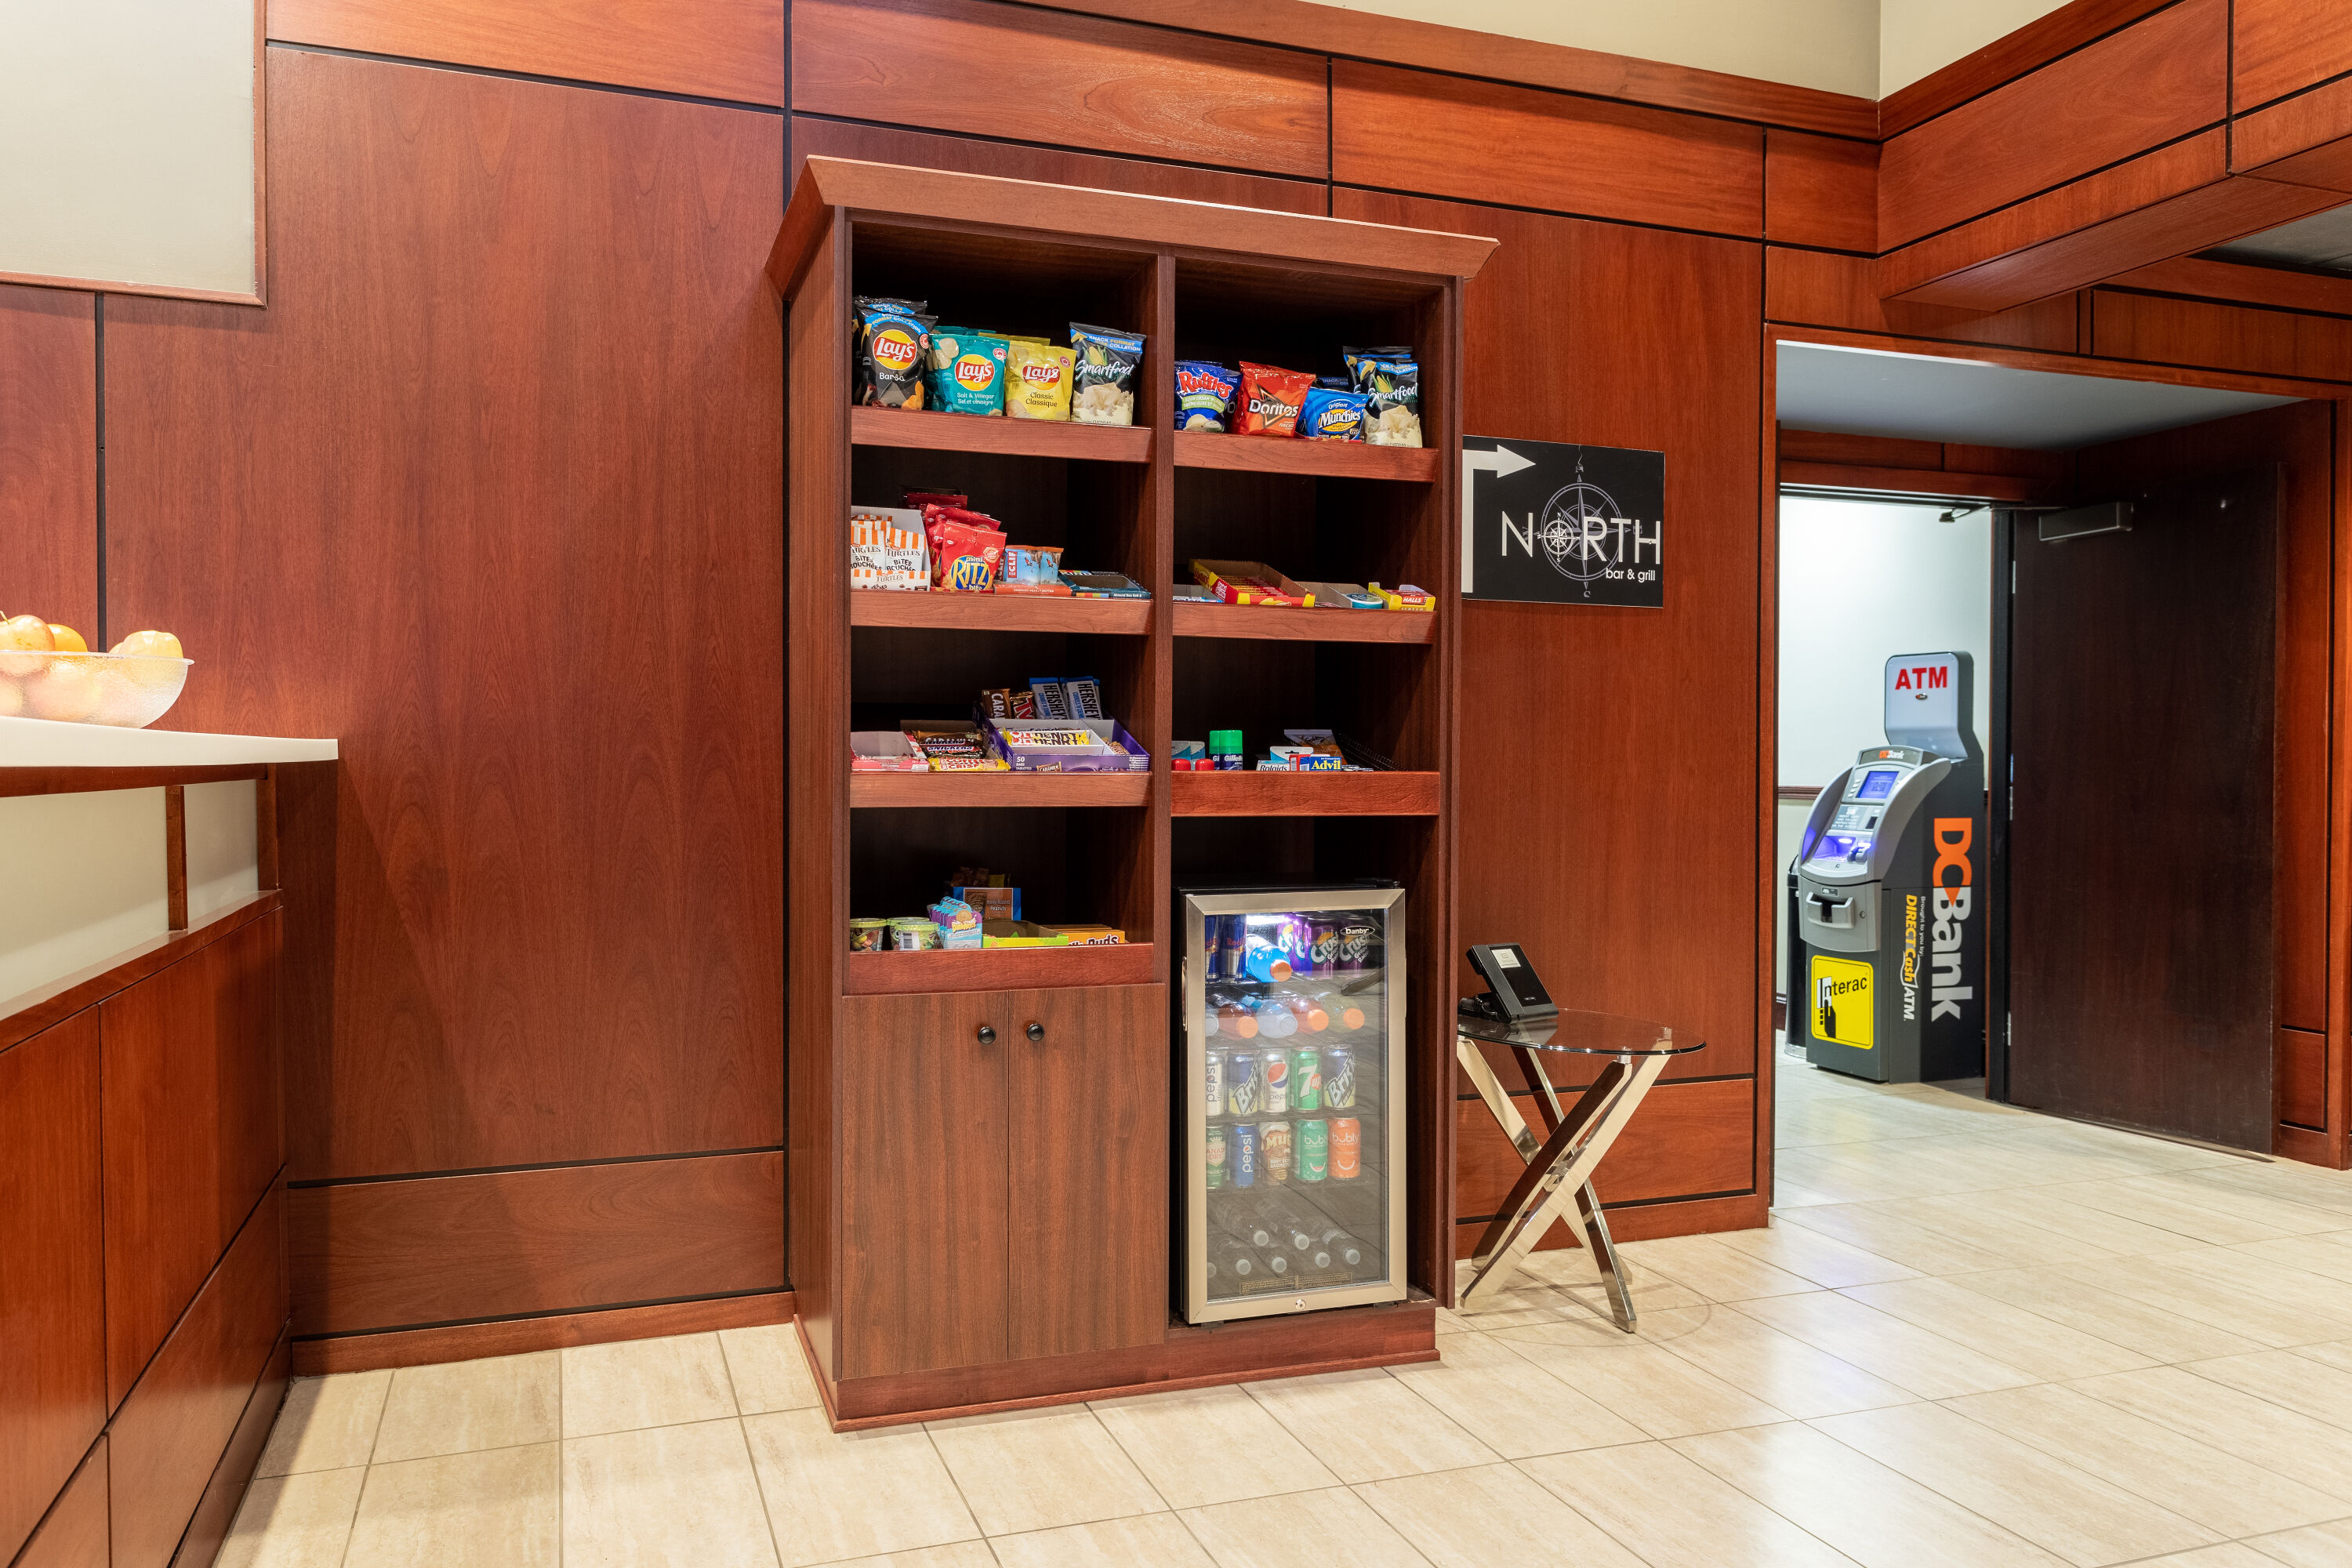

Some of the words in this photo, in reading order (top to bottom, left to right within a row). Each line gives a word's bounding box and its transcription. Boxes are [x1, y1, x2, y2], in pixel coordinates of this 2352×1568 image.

[893, 317, 922, 333] COLLATION
[877, 338, 915, 361] Lay's
[1109, 338, 1135, 347] FORMAT
[958, 363, 992, 383] Lay's
[1025, 365, 1059, 383] Lay's
[1075, 360, 1135, 381] Smartfood
[1176, 371, 1234, 399] Ruffles
[1367, 382, 1418, 407] Smartfood
[1025, 398, 1058, 408] Classique
[1249, 399, 1299, 417] Doritos
[1319, 410, 1361, 429] Munchies
[886, 548, 920, 557] TURTLES
[952, 558, 989, 588] RITZ
[1606, 568, 1624, 579] bar
[1627, 568, 1635, 579] &
[1637, 569, 1656, 583] grill
[1895, 666, 1947, 690] ATM
[1311, 760, 1341, 770] Advil
[1905, 895, 1918, 947] DIRECT
[1931, 818, 1973, 1022] DCBank
[1904, 948, 1916, 982] Cash
[1818, 977, 1867, 1007] Interac
[1903, 986, 1915, 1020] ATM
[1206, 1063, 1217, 1102] pepsi
[1241, 1134, 1253, 1172] pepsi
